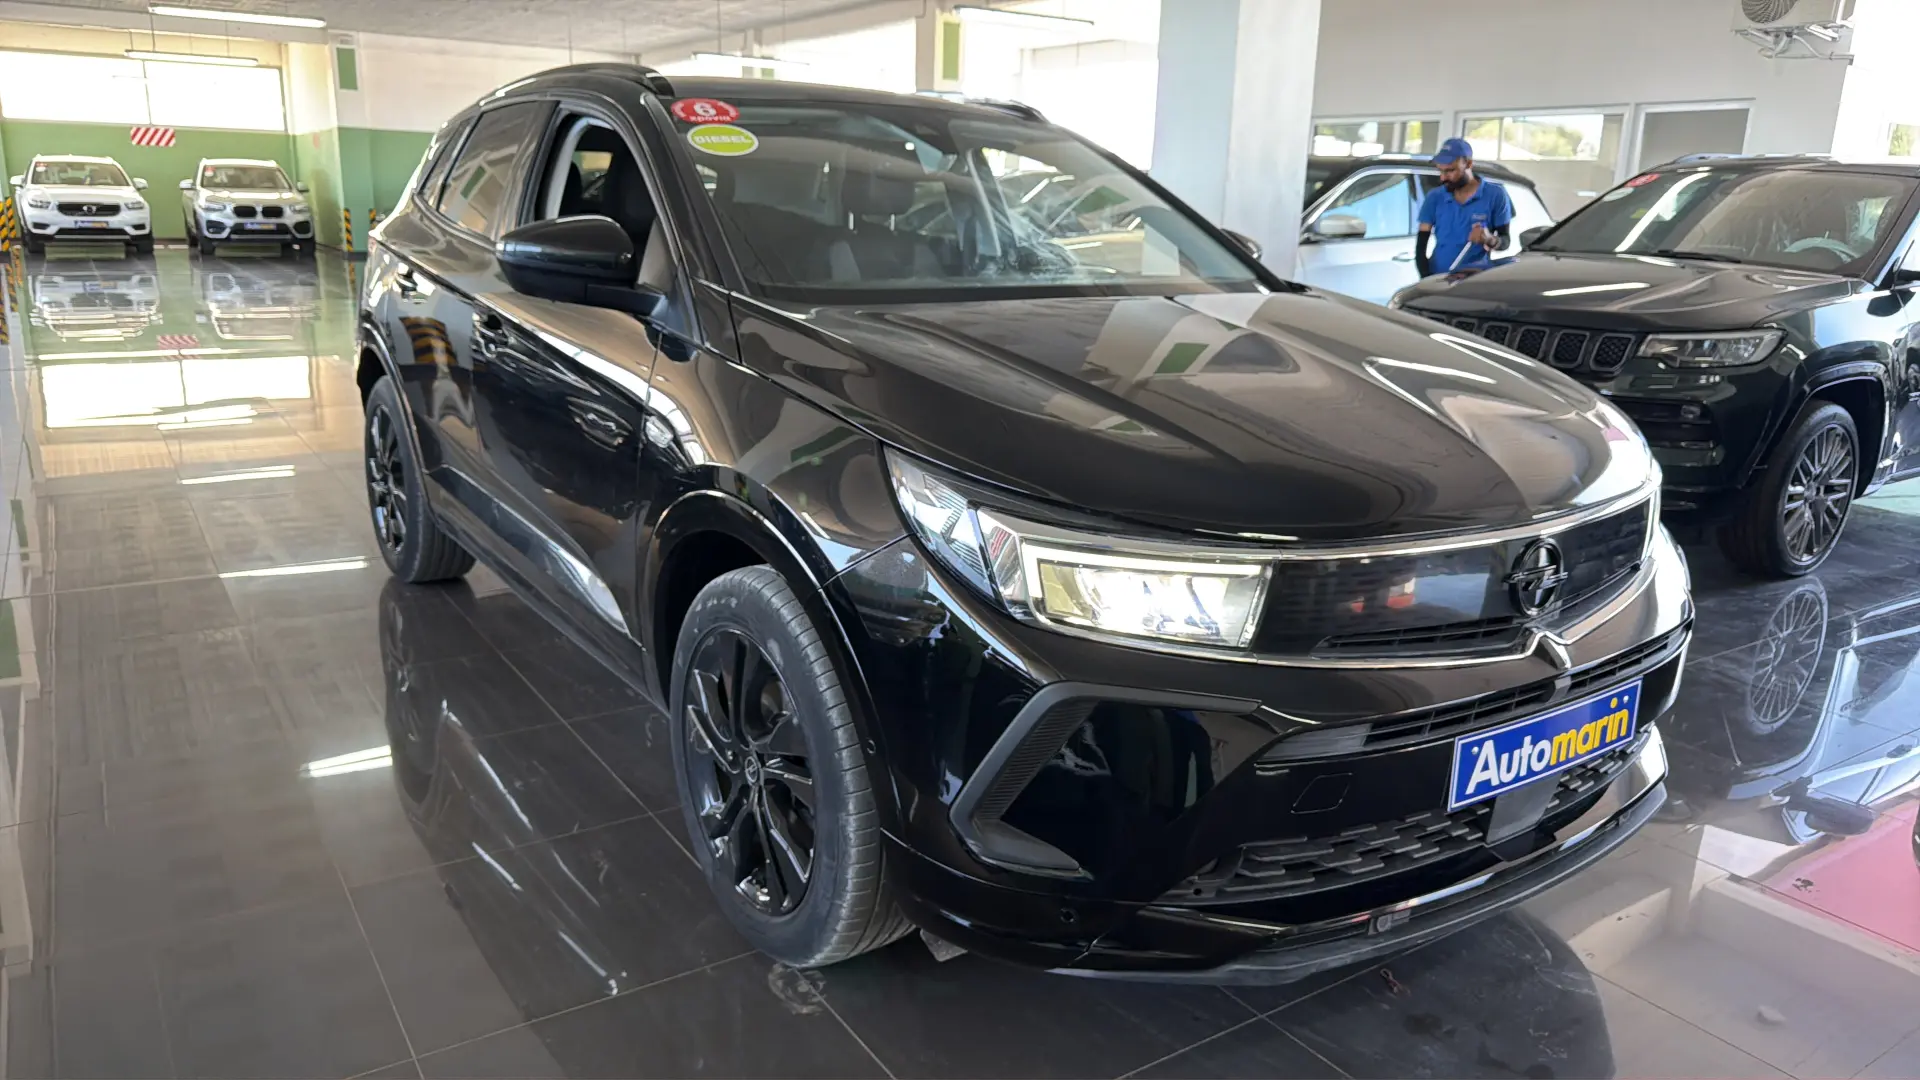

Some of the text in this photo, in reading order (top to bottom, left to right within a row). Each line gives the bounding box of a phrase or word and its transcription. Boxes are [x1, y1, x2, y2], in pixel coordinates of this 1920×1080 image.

[693, 102, 717, 117] 6
[694, 135, 752, 144] DIESEL
[1465, 697, 1629, 795] Automarin
